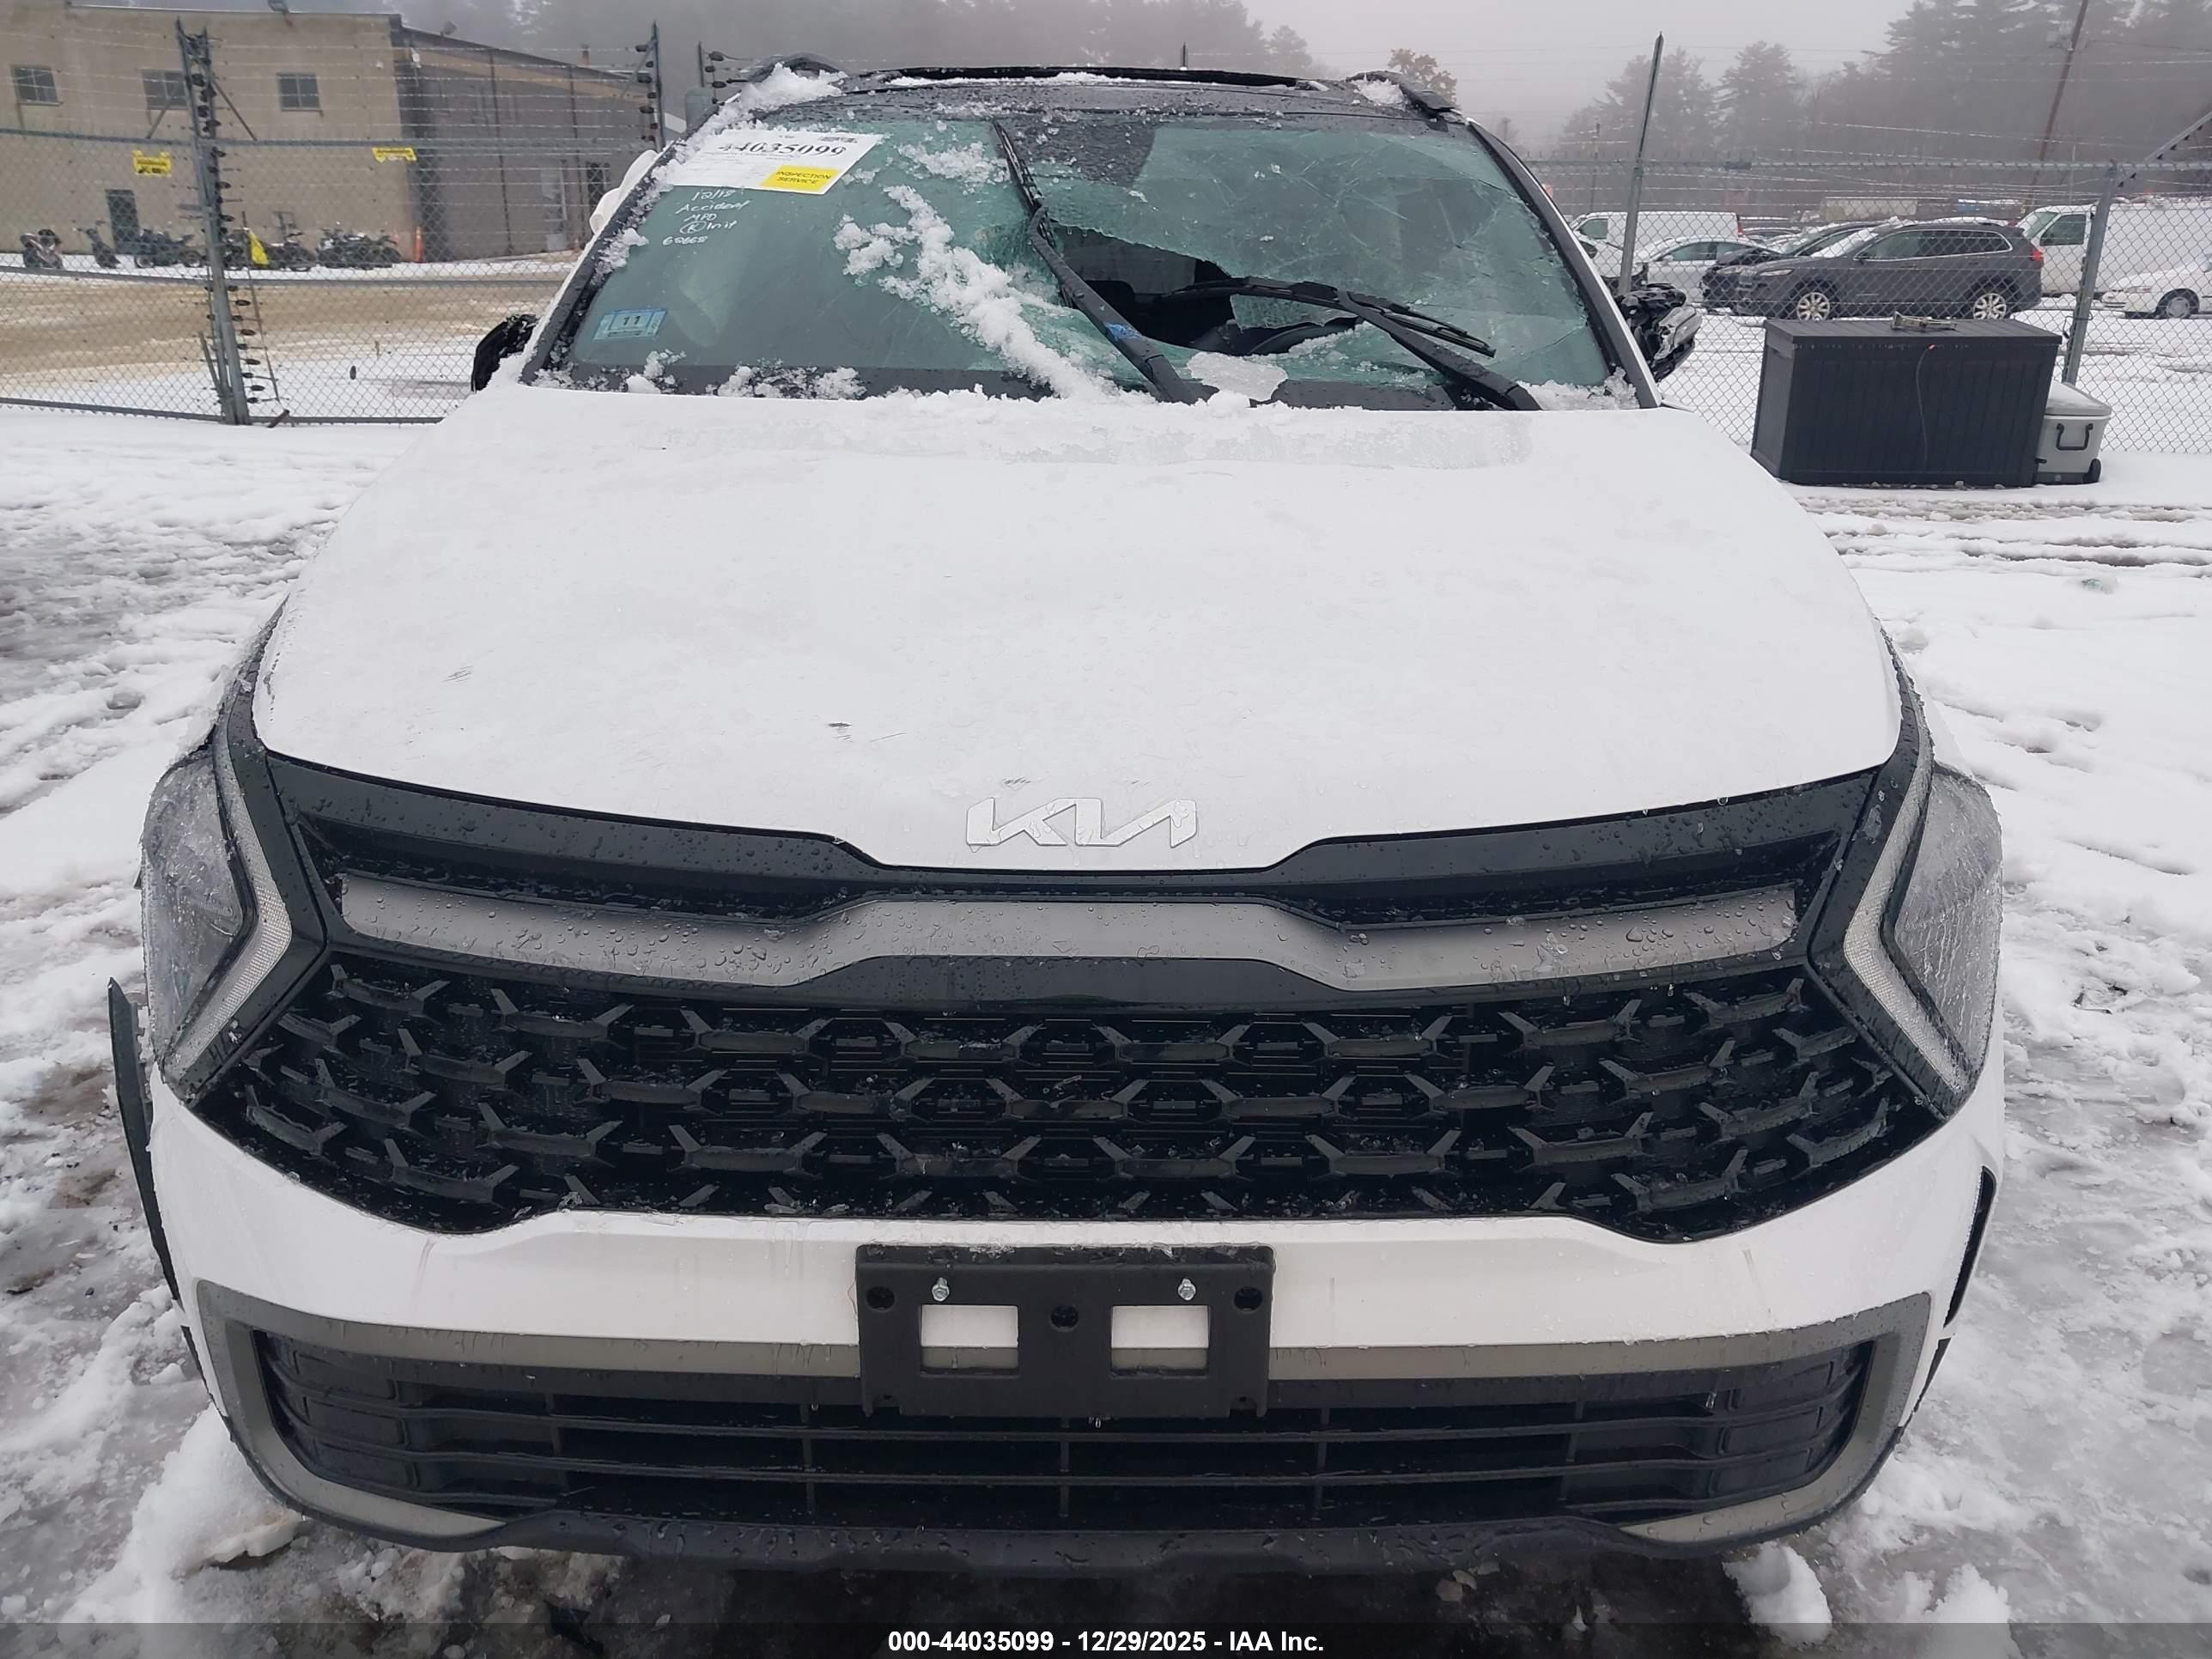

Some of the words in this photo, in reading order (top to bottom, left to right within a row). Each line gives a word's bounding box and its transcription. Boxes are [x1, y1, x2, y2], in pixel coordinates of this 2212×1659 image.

[776, 171, 831, 179] INSPECTION
[623, 315, 641, 325] 11
[966, 796, 1197, 848] KIA
